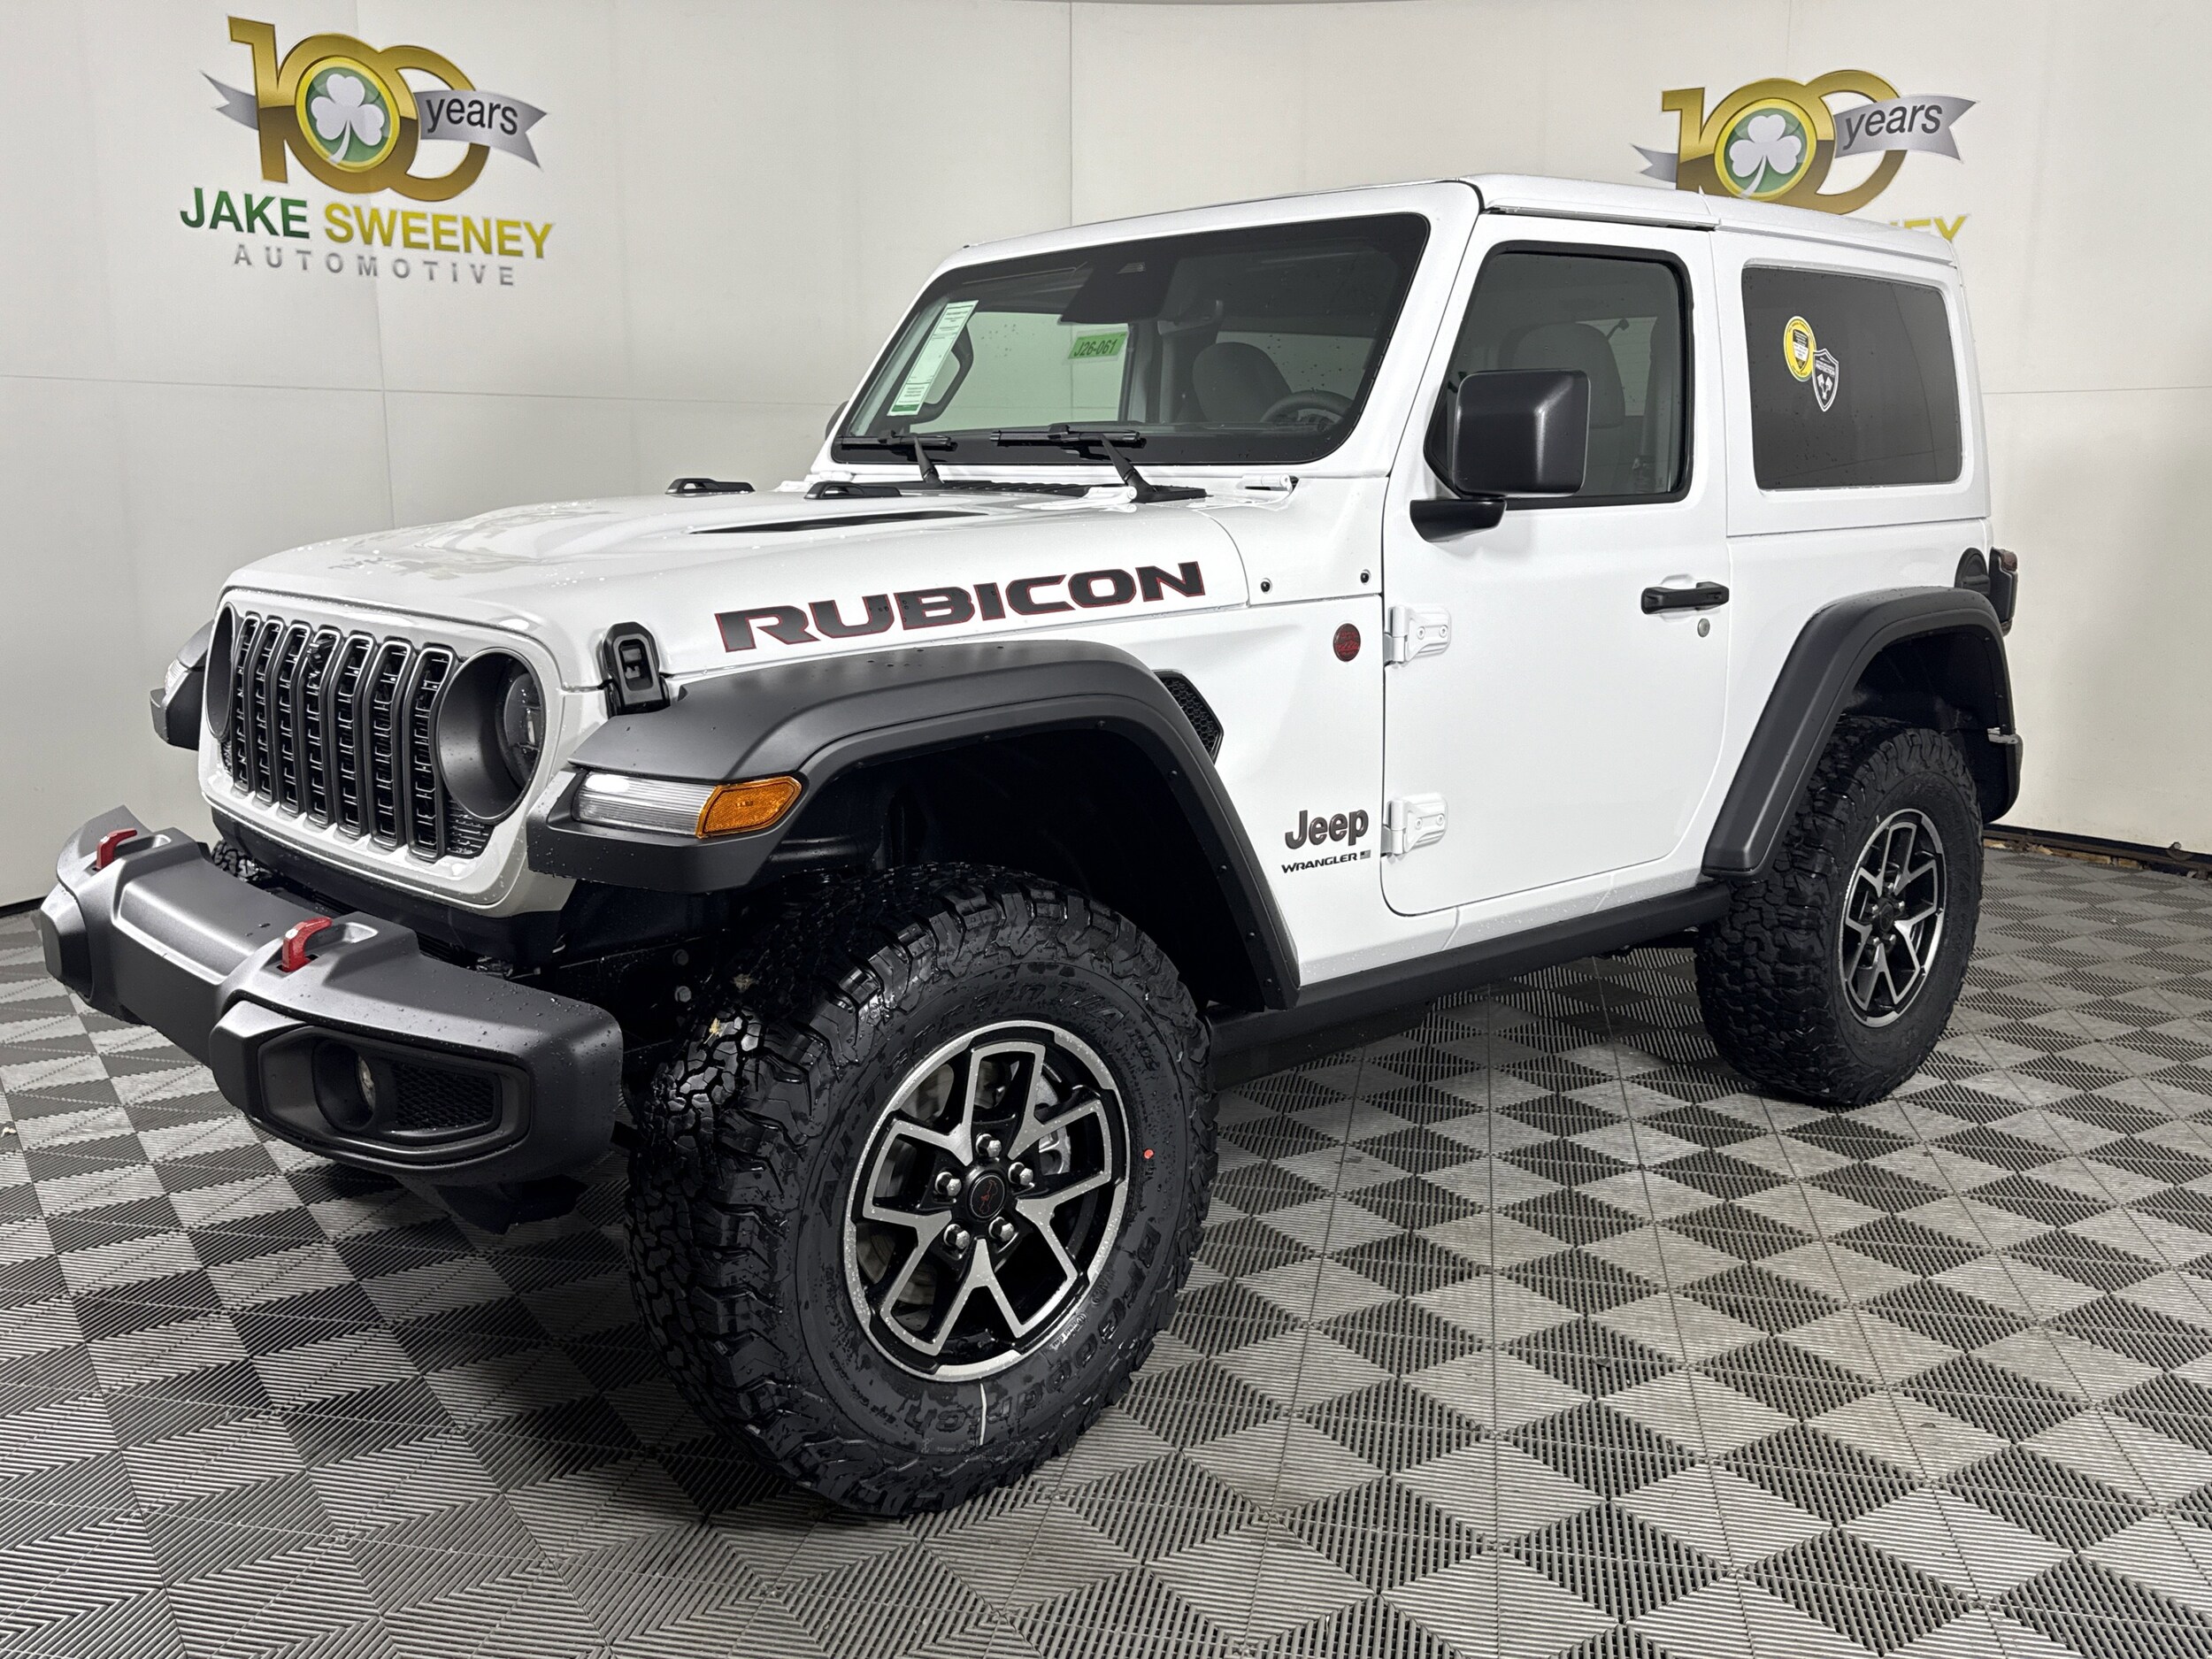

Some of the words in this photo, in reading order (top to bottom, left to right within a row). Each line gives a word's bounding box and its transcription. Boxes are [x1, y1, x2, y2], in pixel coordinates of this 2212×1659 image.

[227, 16, 490, 202] 100
[426, 96, 518, 135] years
[1662, 70, 1909, 215] 100
[1843, 104, 1942, 150] years
[180, 187, 310, 240] JAKE
[324, 203, 553, 258] SWEENEY
[234, 244, 514, 286] AUTOMOTIVE
[1073, 338, 1118, 357] J26-061
[714, 561, 1205, 653] RUBICON
[1285, 809, 1369, 849] Jeep
[1280, 852, 1357, 874] WRANGLER
